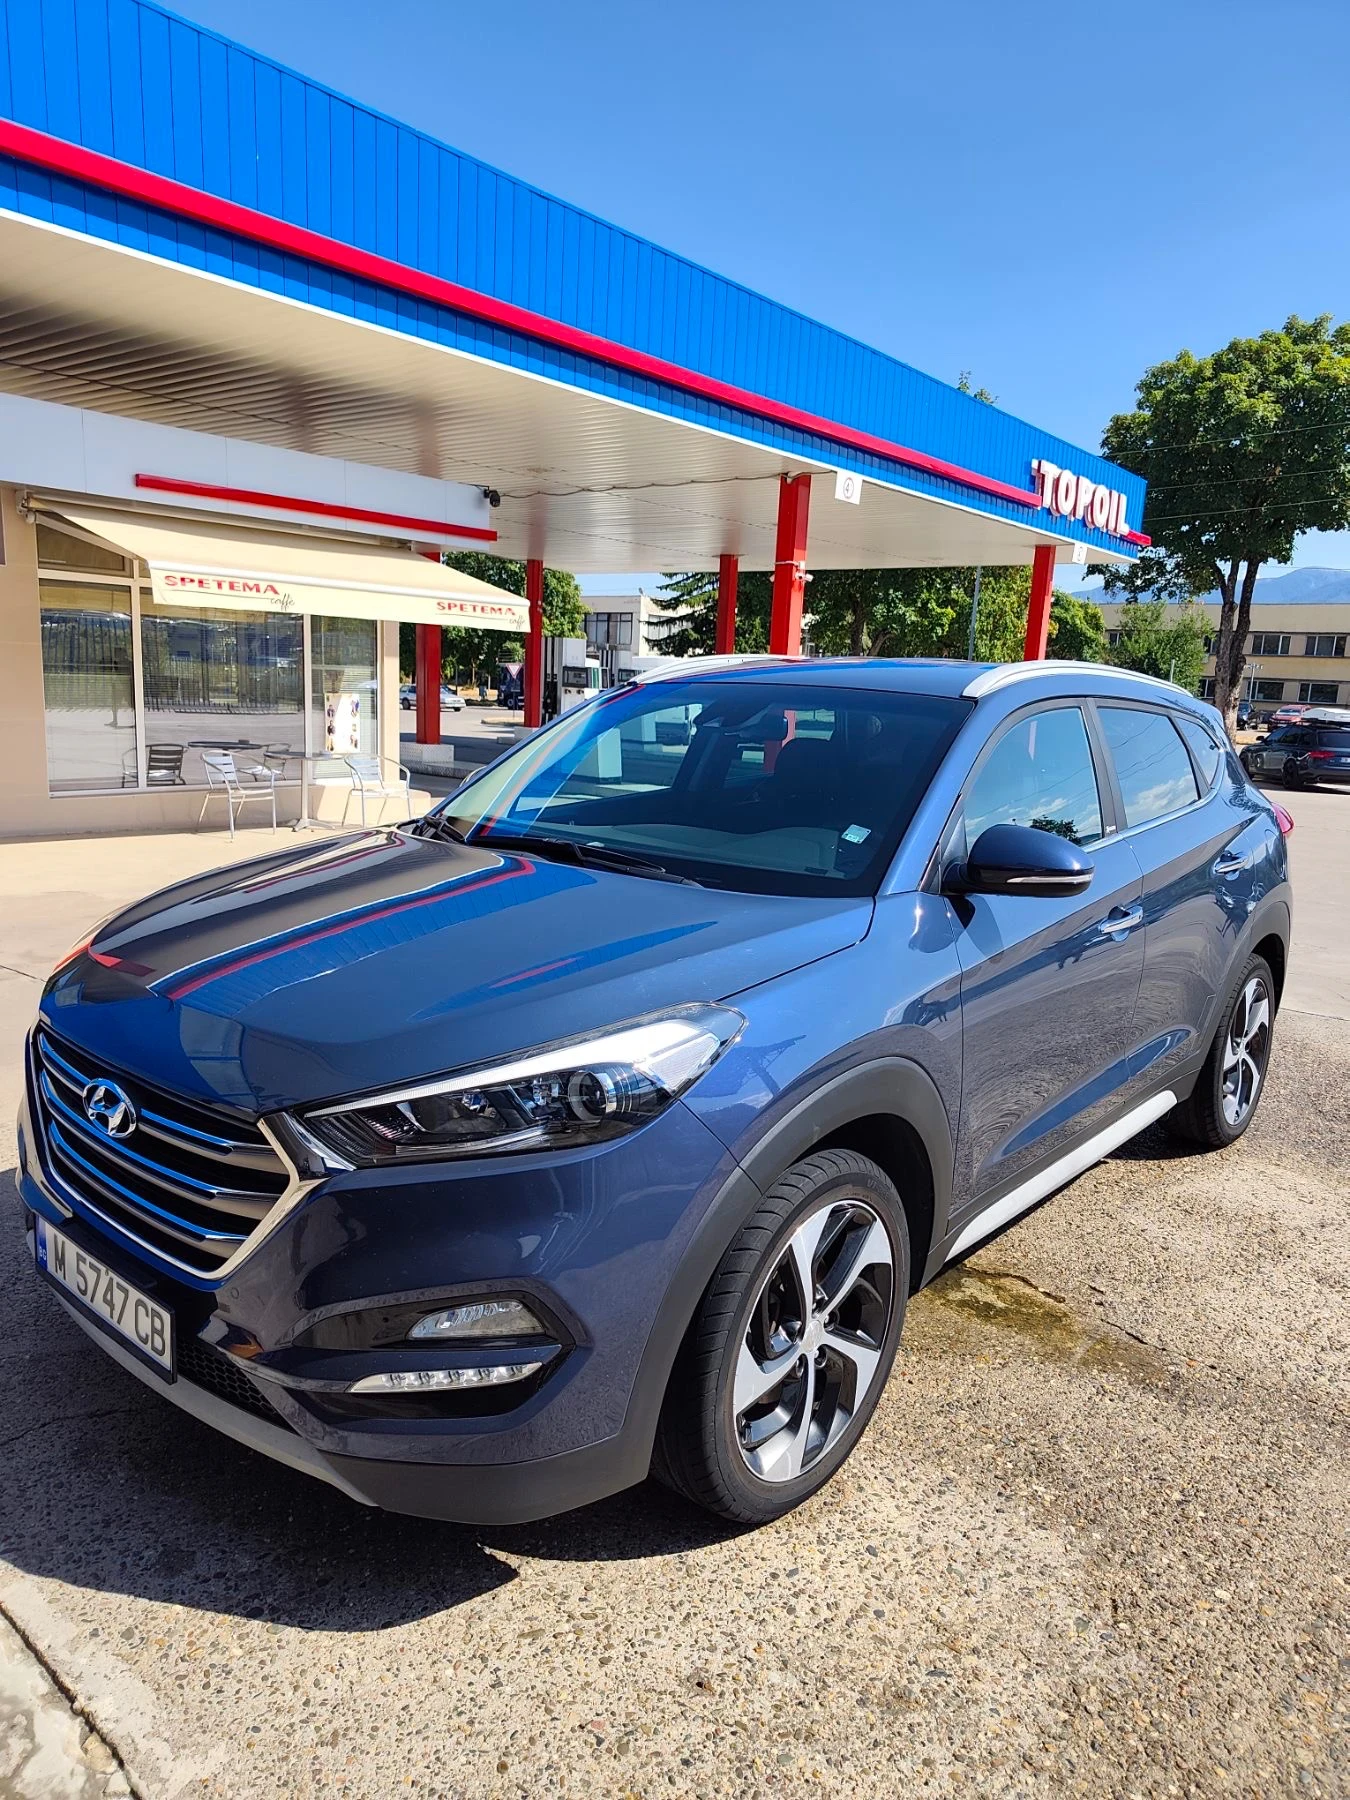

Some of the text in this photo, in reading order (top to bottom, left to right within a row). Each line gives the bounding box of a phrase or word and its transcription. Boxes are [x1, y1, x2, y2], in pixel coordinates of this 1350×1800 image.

[1031, 458, 1130, 537] TOPOIL
[164, 575, 280, 595] SPETEMA
[436, 601, 516, 616] SPETEMA
[54, 1234, 166, 1357] M 5747 CB
